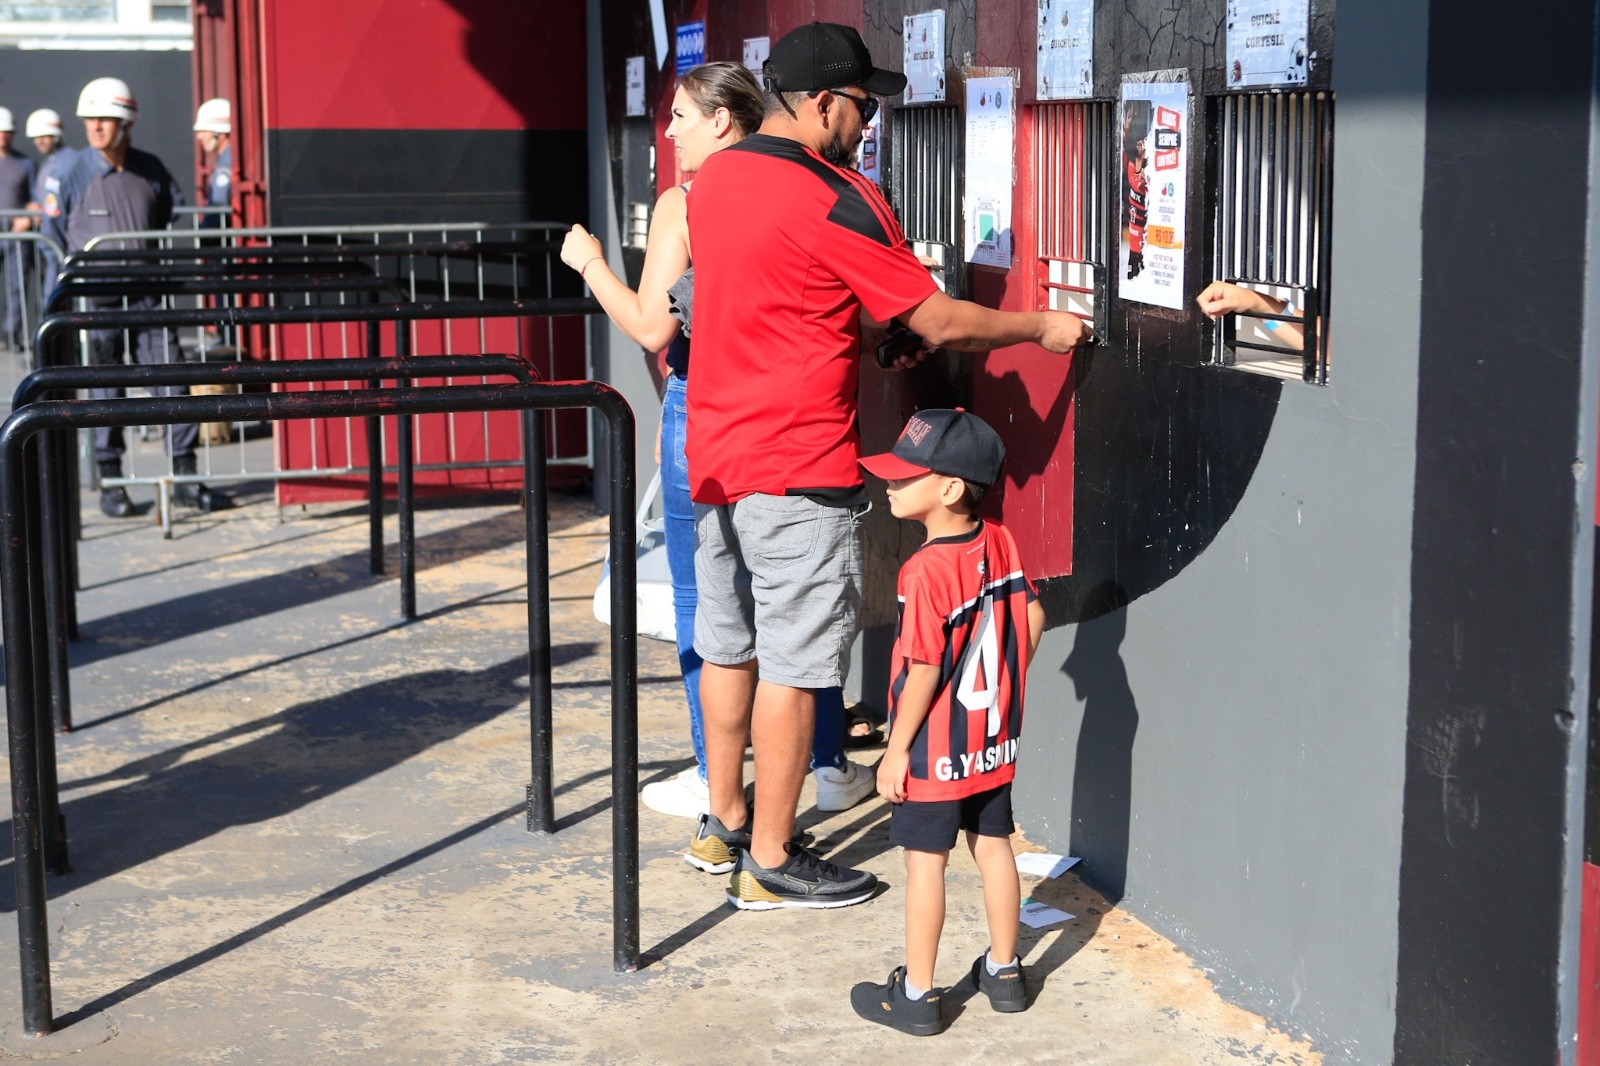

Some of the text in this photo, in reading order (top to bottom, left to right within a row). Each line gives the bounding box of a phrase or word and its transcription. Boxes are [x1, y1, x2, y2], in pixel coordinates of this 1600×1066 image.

[1245, 34, 1285, 48] CORTESIA
[956, 594, 999, 738] 4
[935, 737, 1021, 782] G.YASMIN
